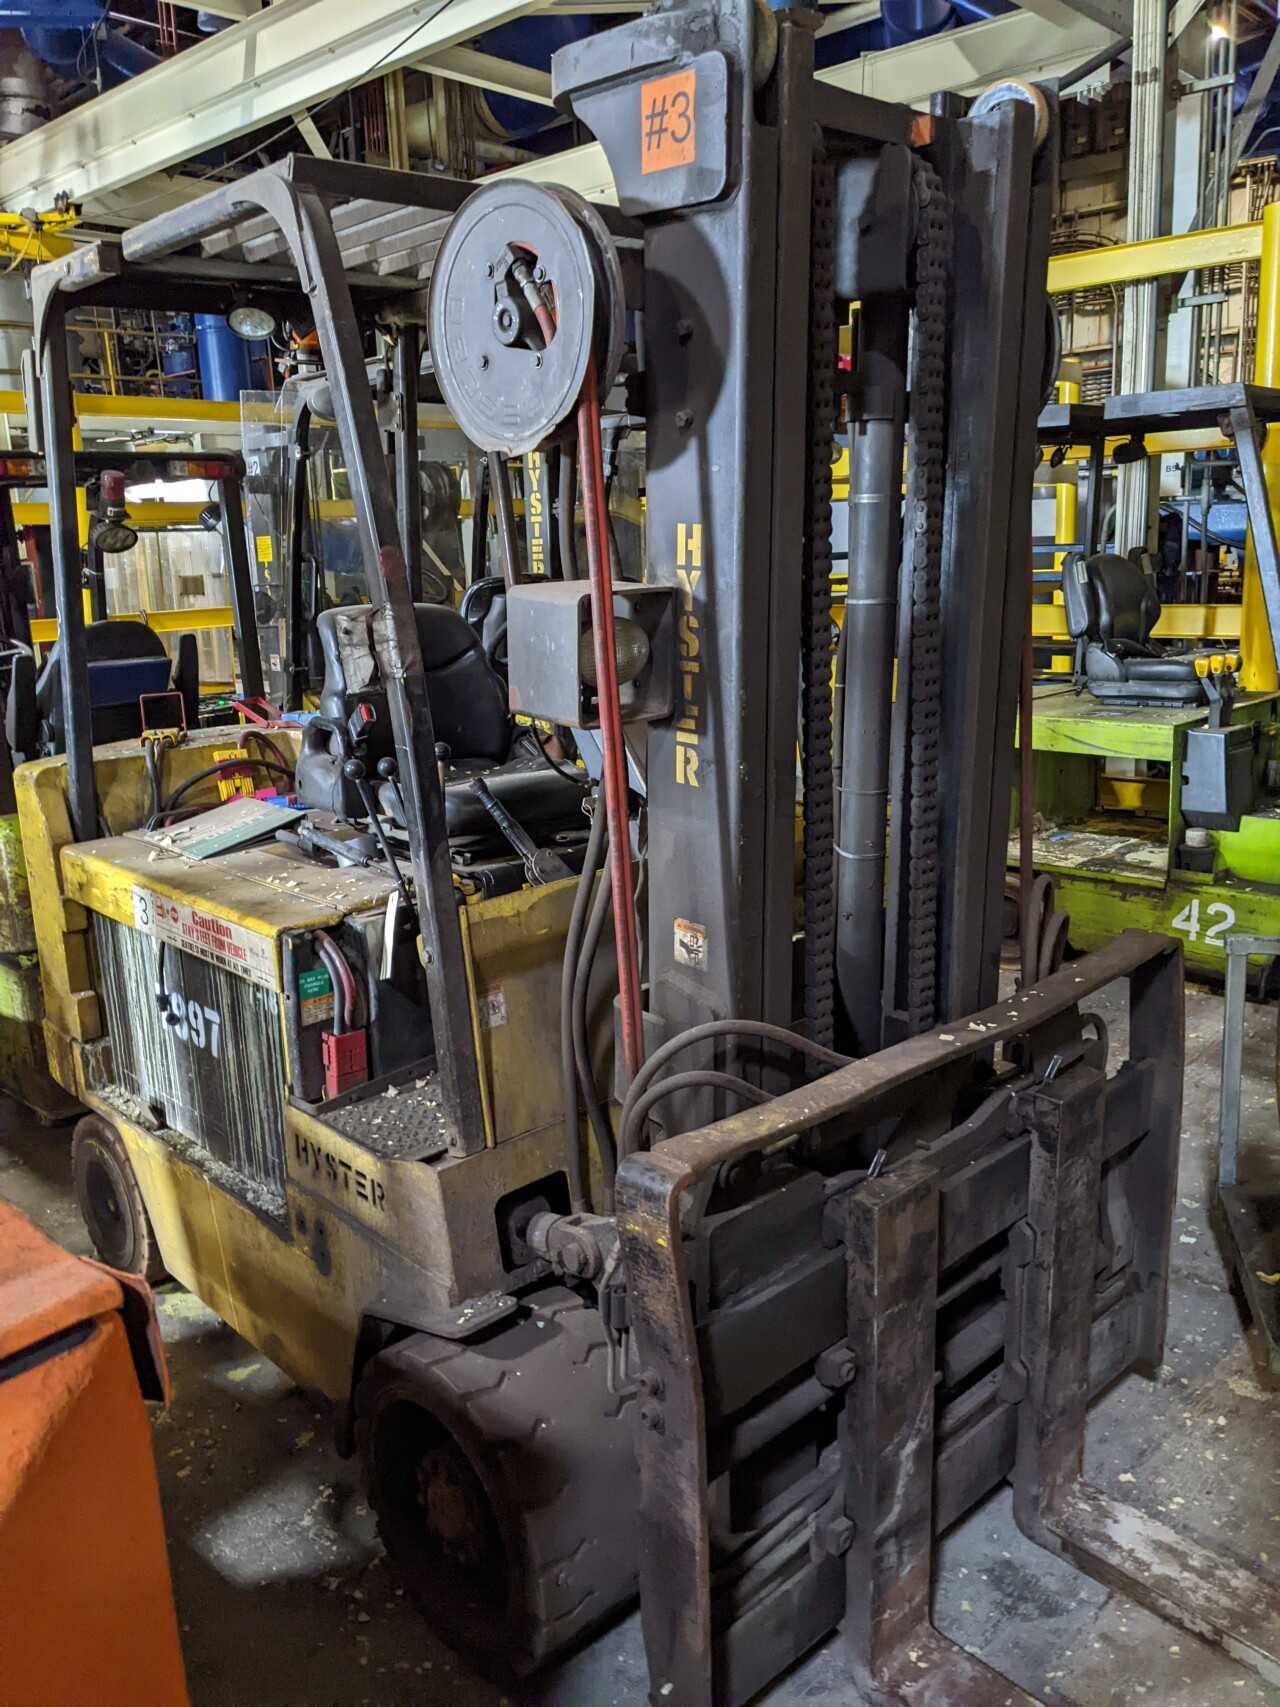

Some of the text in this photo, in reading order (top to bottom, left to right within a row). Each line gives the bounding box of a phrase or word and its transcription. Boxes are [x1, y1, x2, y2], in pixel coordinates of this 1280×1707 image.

[645, 91, 691, 151] #3
[675, 523, 702, 787] HYSTER
[139, 896, 149, 925] 3
[192, 911, 232, 940] Caution
[1172, 899, 1235, 947] 42
[295, 1133, 385, 1212] HYSTER
